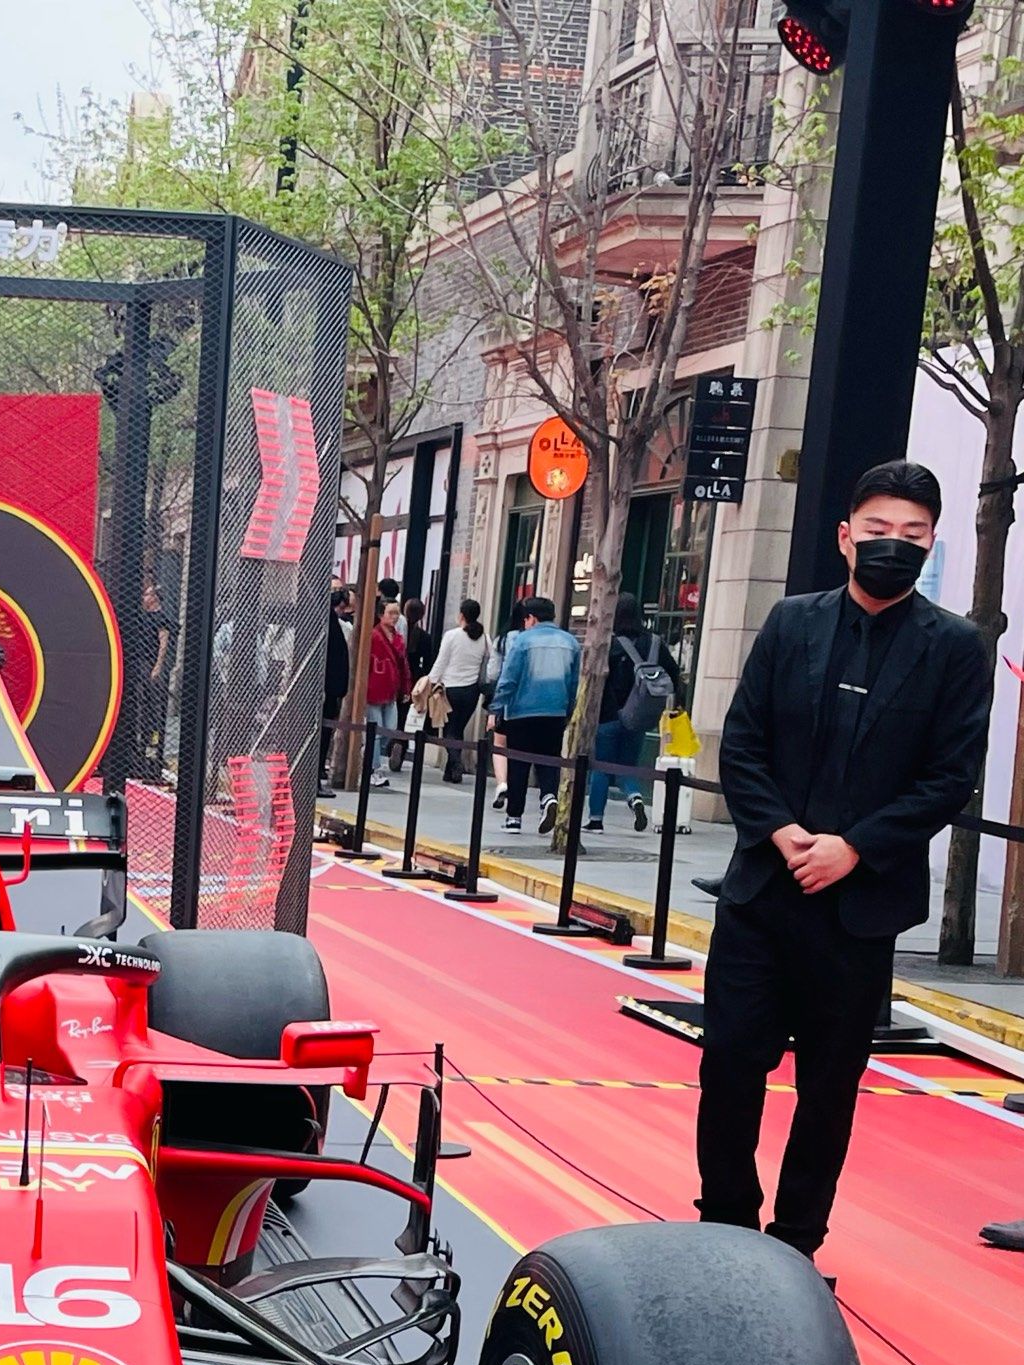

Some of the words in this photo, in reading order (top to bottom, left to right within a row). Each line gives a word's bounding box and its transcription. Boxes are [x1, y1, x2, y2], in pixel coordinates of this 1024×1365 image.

[694, 481, 731, 498] OLLA
[78, 943, 113, 968] DXC
[61, 1016, 113, 1039] Ray-Ban
